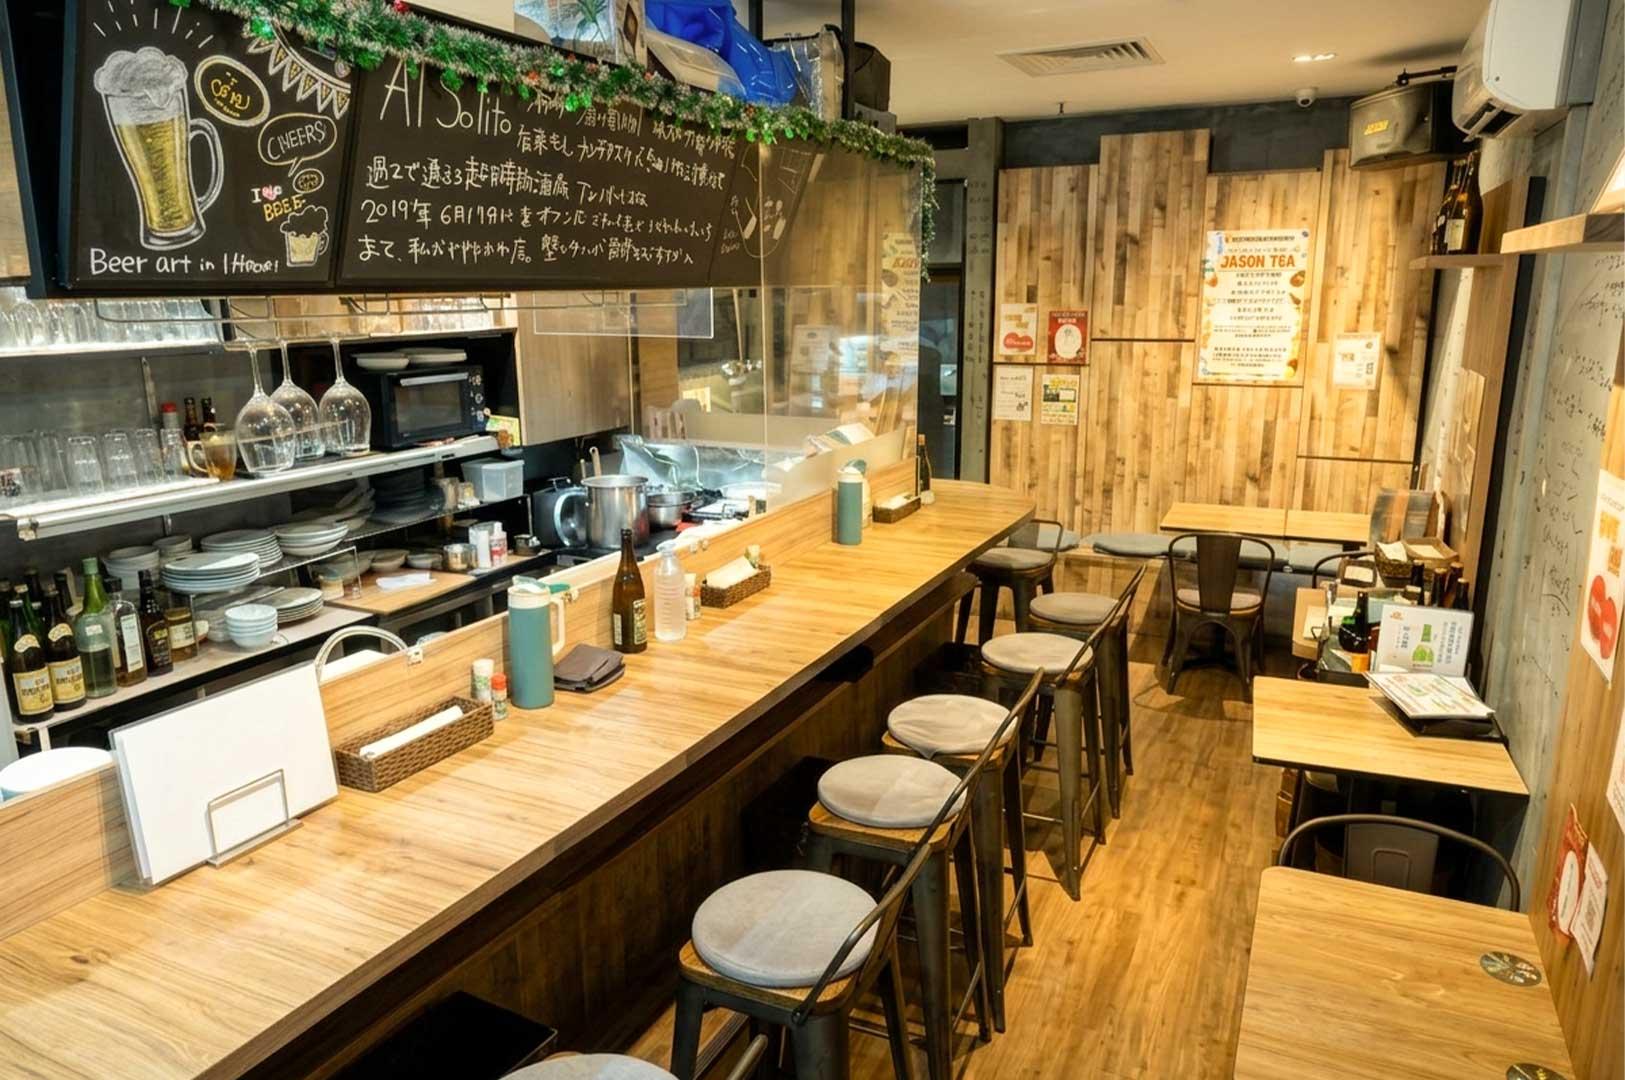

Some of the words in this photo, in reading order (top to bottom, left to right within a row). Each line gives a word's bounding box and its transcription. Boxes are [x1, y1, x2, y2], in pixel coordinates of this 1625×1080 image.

[90, 247, 149, 275] Beer
[156, 252, 192, 274] art
[199, 257, 215, 272] in
[1220, 254, 1265, 269] JASON
